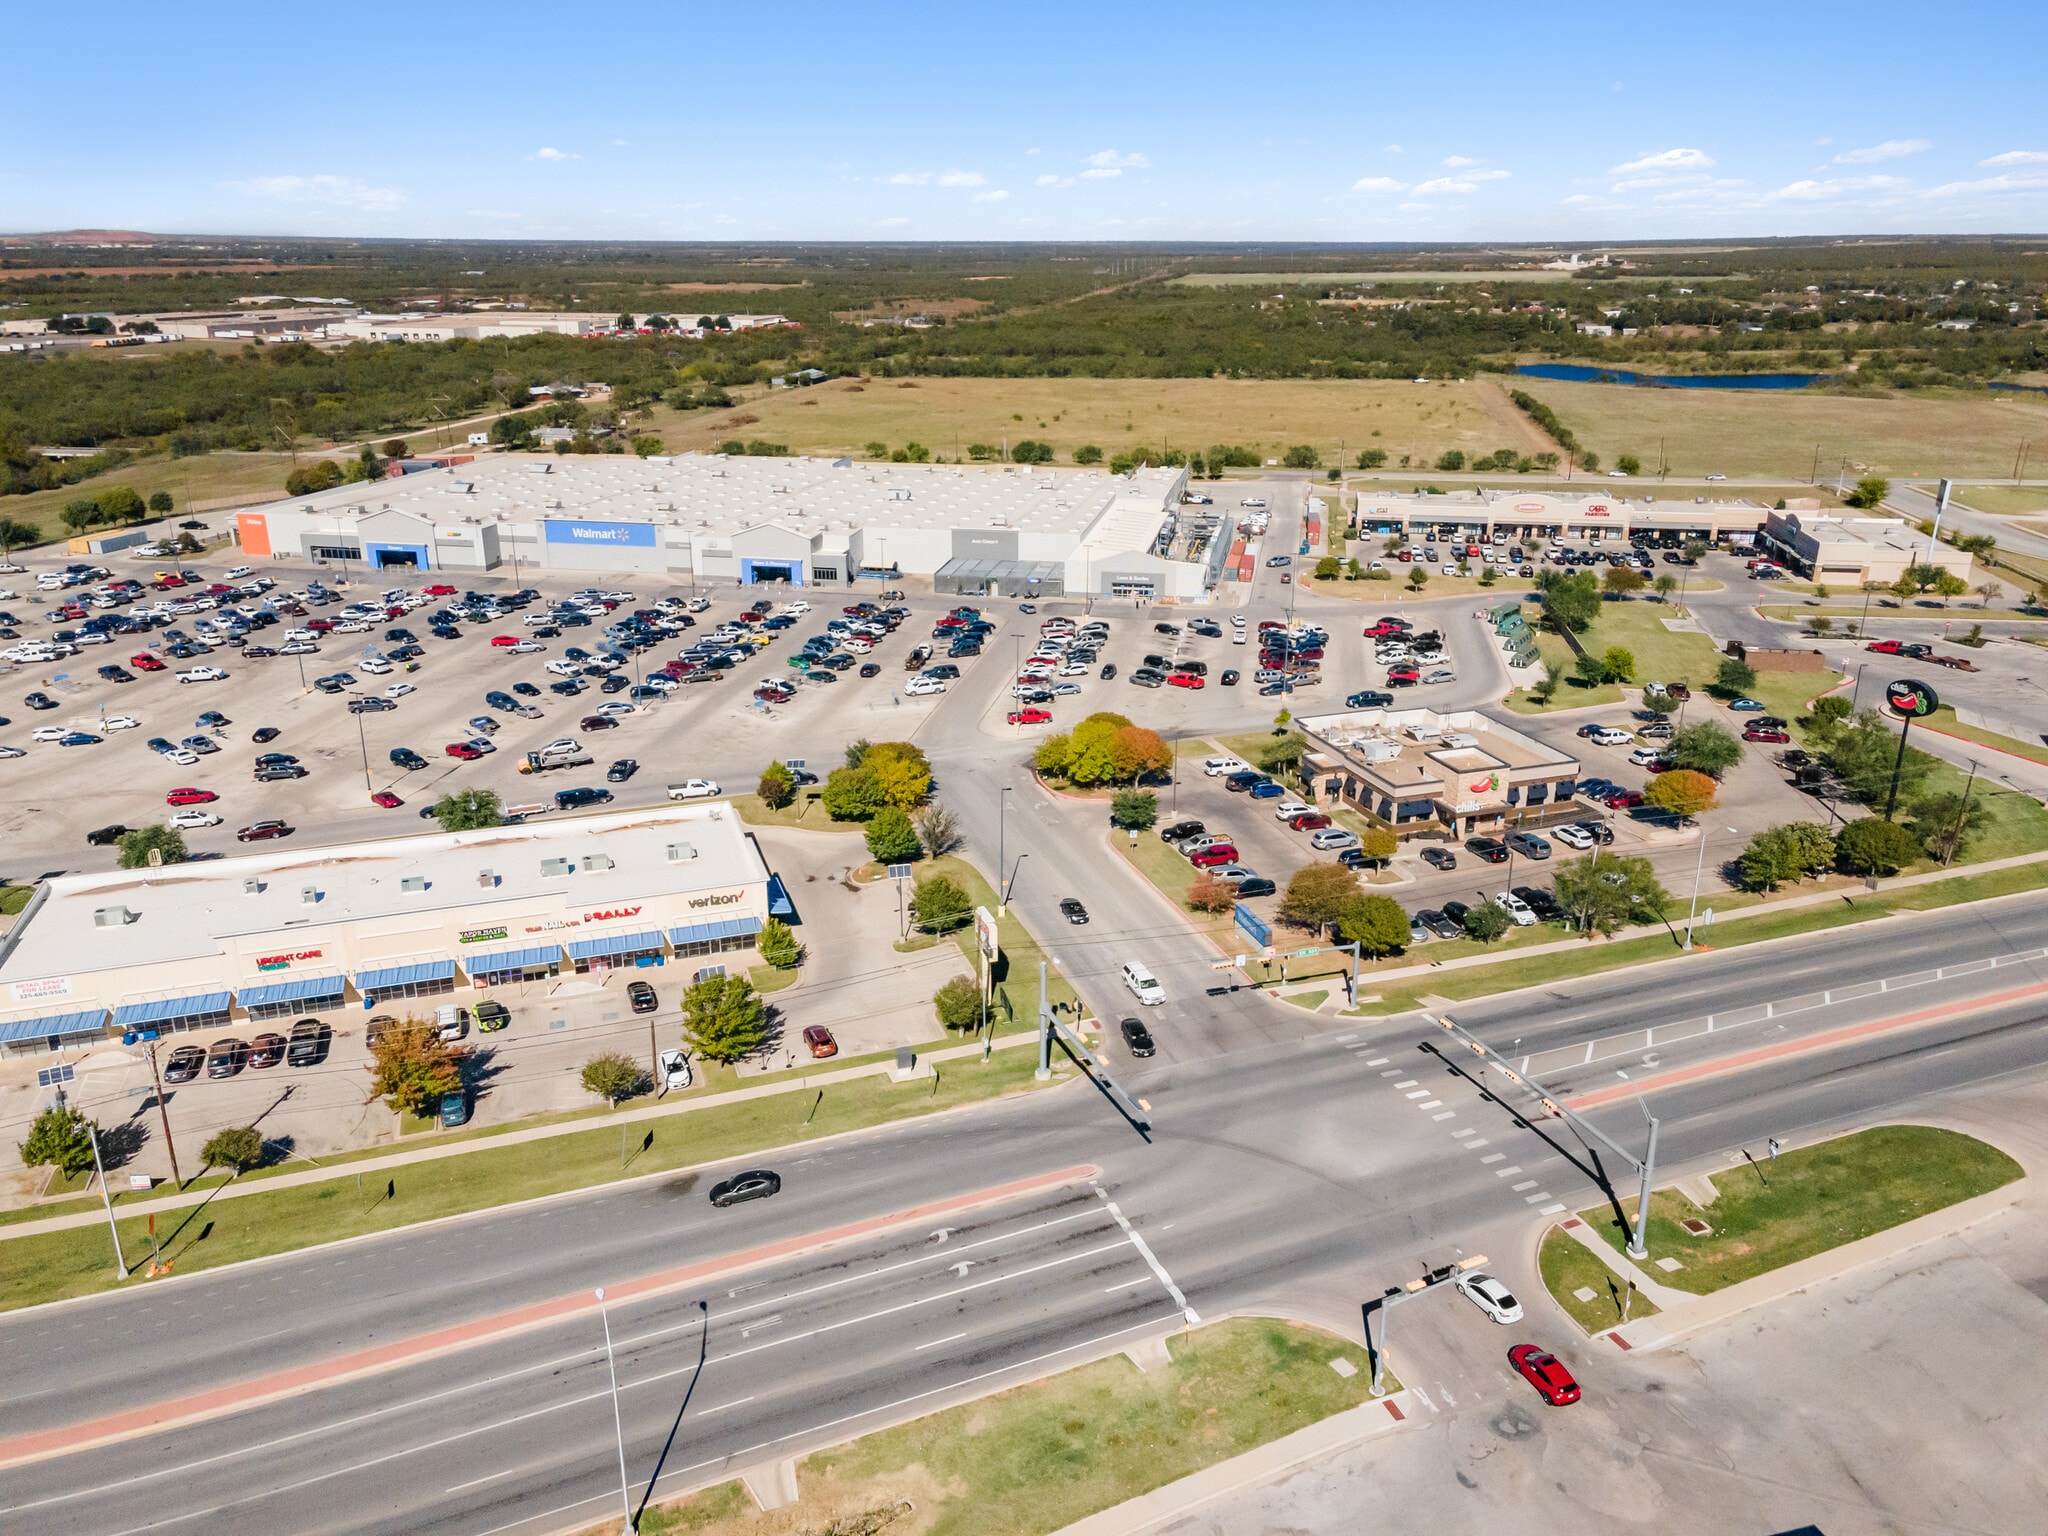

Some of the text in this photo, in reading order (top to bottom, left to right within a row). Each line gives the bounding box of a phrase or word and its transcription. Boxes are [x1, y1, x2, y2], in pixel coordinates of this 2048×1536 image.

[571, 527, 616, 539] Walmart
[688, 894, 739, 908] verizon
[592, 906, 642, 920] SALLY
[255, 950, 322, 965] URGENT CARE
[42, 978, 65, 986] SPACE
